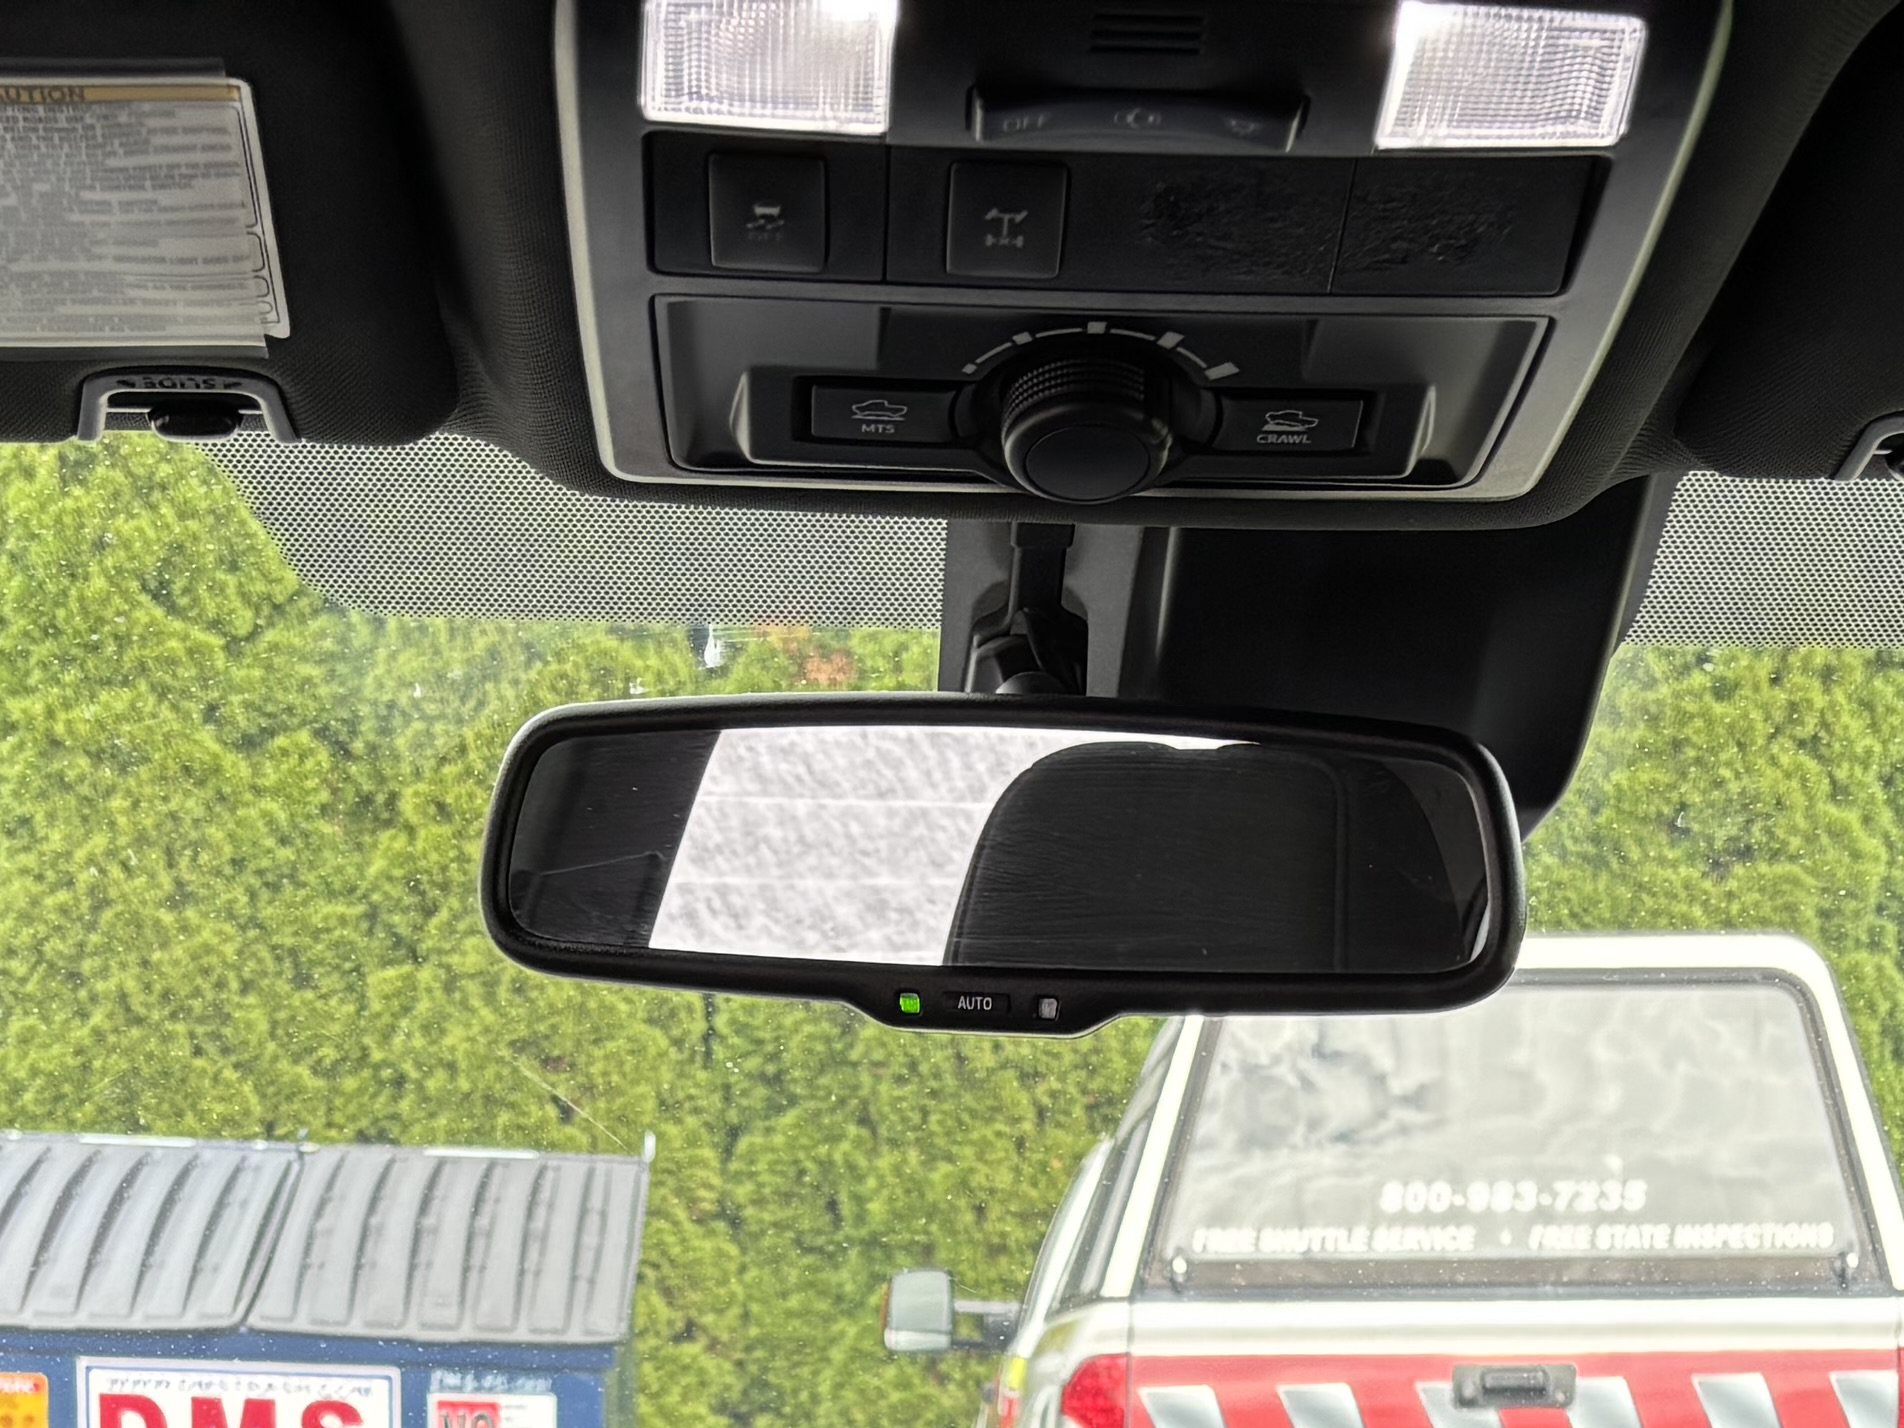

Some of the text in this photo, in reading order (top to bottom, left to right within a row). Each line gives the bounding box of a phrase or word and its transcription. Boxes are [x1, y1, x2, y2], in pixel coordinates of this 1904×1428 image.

[861, 424, 895, 434] MTS
[1256, 433, 1312, 445] CRAWL
[957, 995, 993, 1011] AUTO
[1191, 1222, 1837, 1255] FREE SHUTTLE SERVICE FREE STATE INSPECTIONS
